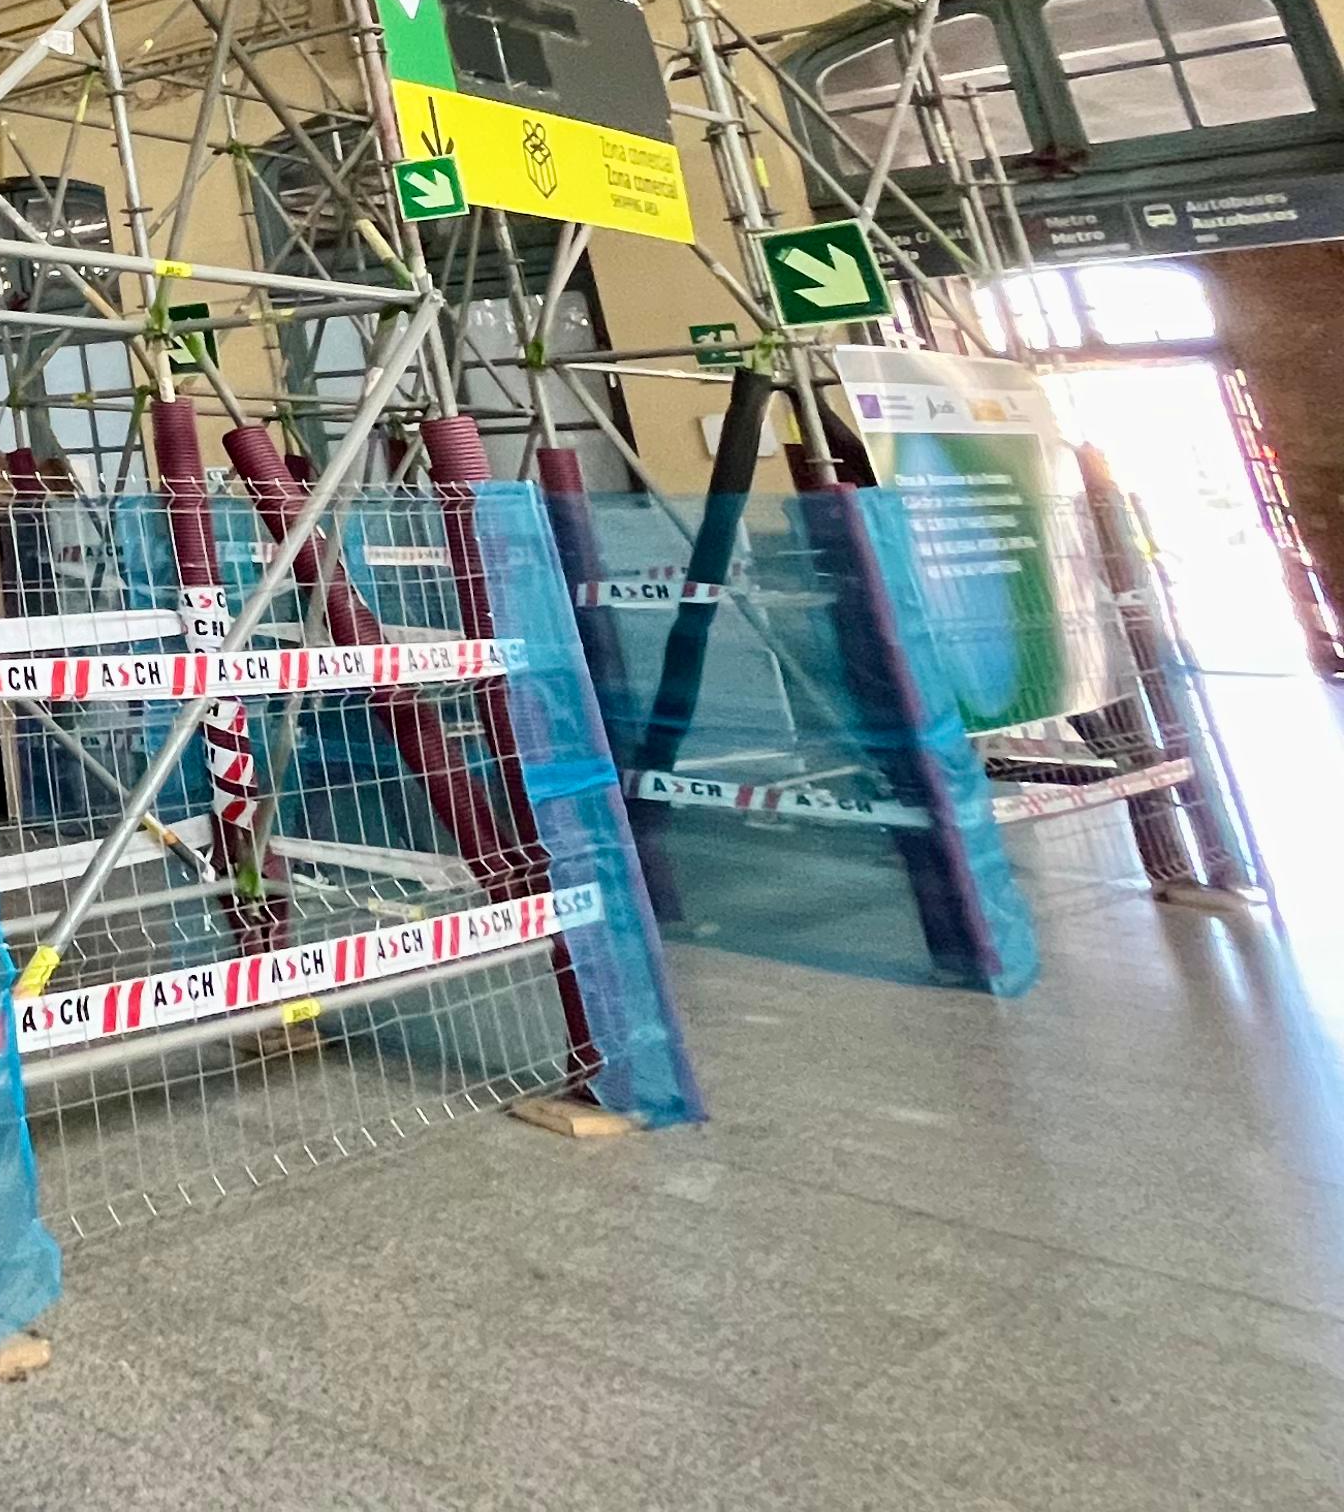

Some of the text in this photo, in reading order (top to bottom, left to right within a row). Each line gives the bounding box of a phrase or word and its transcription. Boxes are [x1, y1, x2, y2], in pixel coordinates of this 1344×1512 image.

[1045, 215, 1098, 229] Metro
[1052, 231, 1105, 245] Metro
[610, 584, 669, 599] ASCH
[102, 661, 162, 687] ASCH
[218, 656, 269, 681] ASCH
[318, 651, 365, 675] ASCH
[653, 777, 722, 798] ASCH
[22, 993, 90, 1032] ASCH
[154, 970, 215, 1008] ASCH
[271, 948, 325, 983] ASCH
[376, 928, 424, 961] ASCH
[468, 908, 513, 940] ASCH
